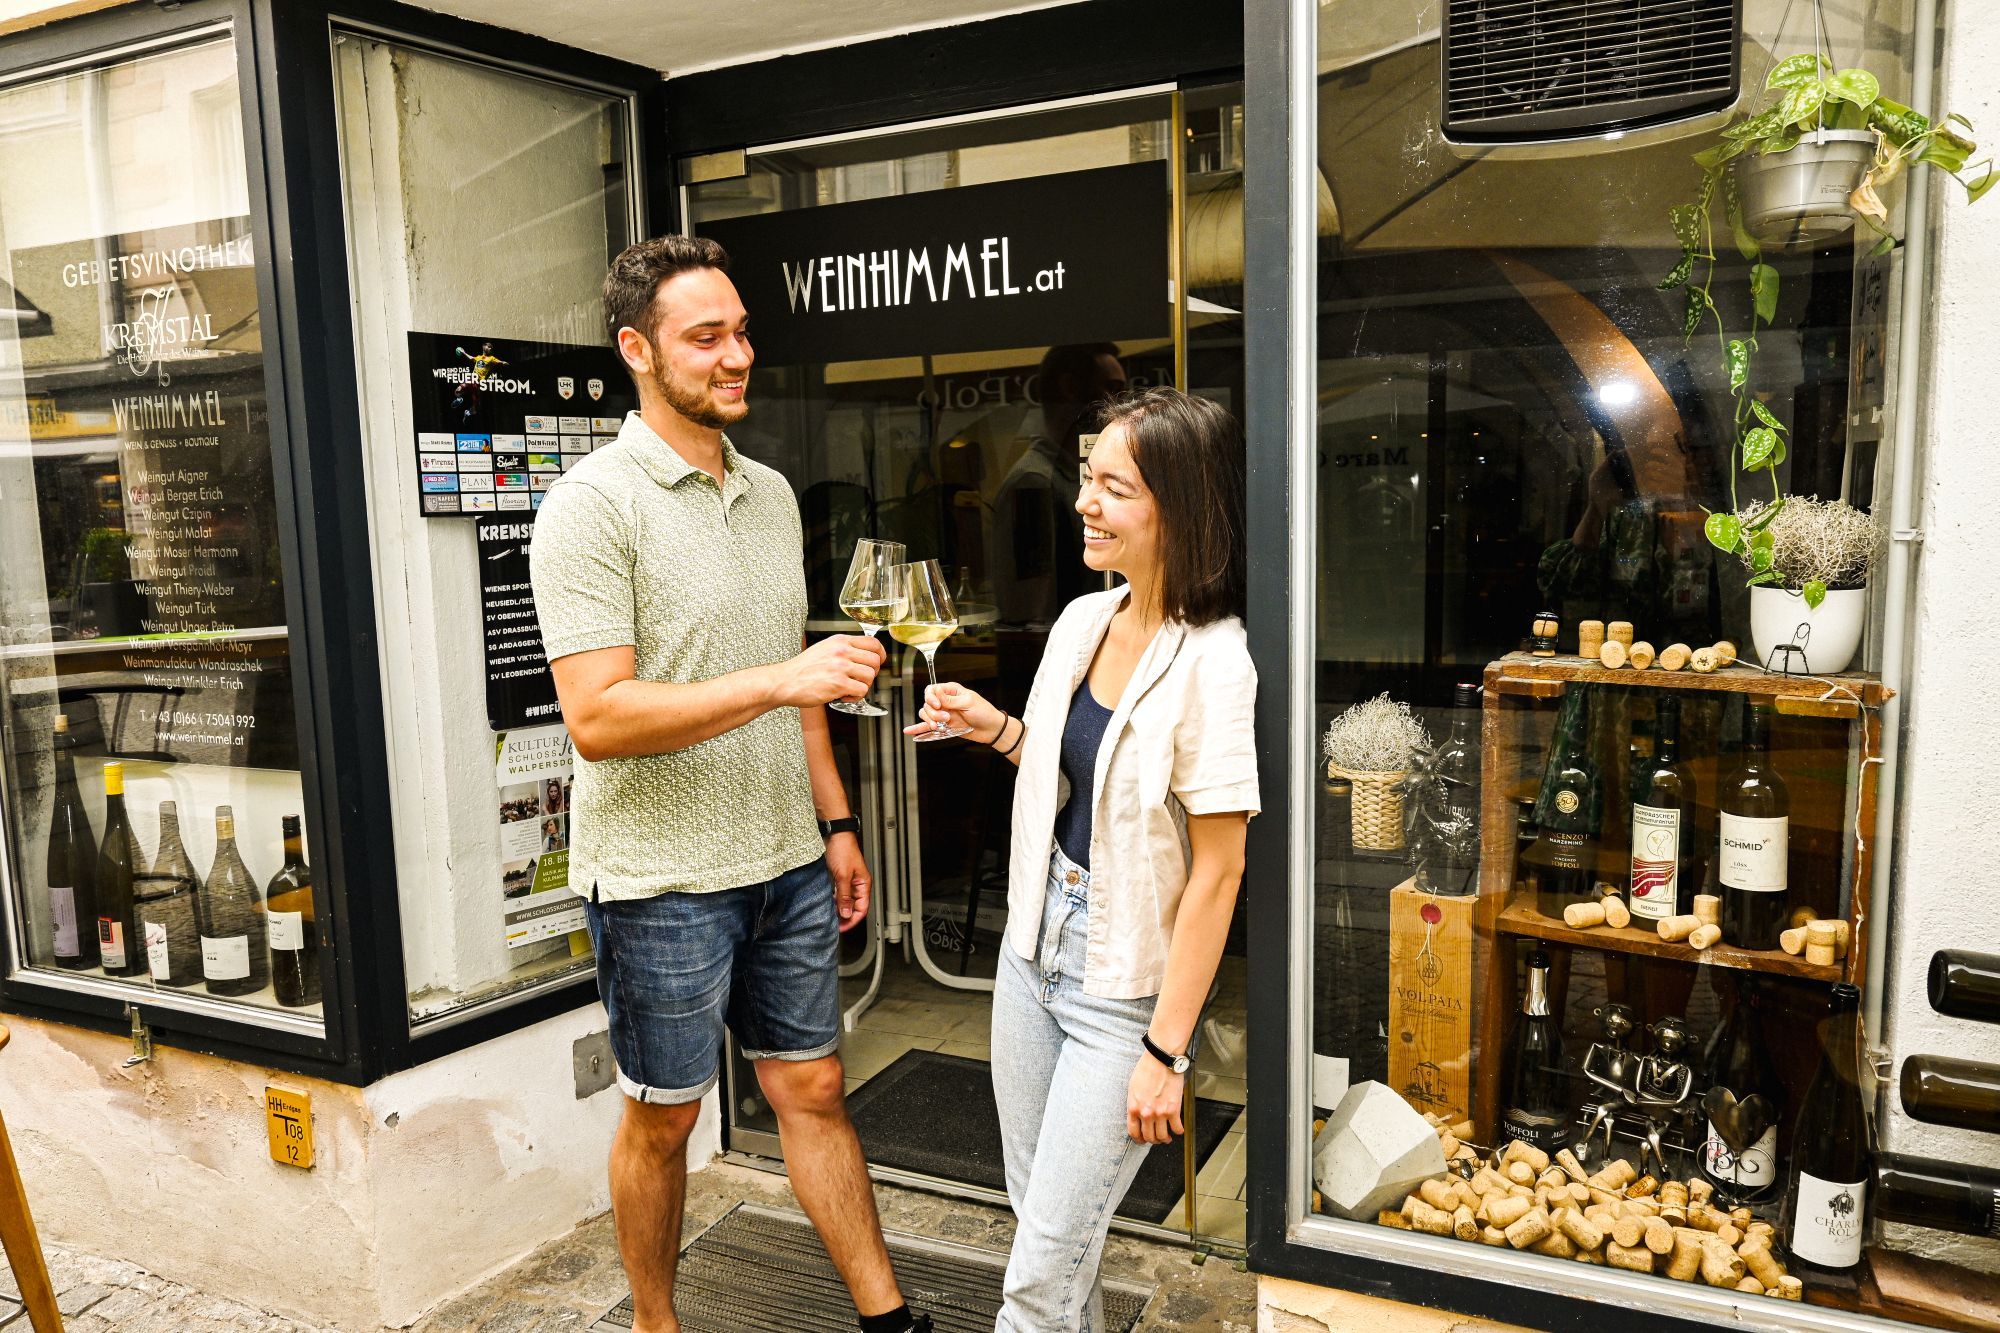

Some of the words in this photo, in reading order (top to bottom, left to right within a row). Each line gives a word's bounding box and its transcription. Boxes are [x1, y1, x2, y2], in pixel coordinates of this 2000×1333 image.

[62, 241, 251, 288] GEBIETSVINOTHEK
[782, 236, 1066, 315] WEINHIMMEL.at
[104, 313, 219, 350] KREMSTAL
[432, 368, 447, 379] WIR
[447, 372, 480, 384] FEUER
[480, 379, 536, 395] STROM.
[112, 390, 226, 431] WEINHIMMEL
[124, 440, 143, 451] WEIN
[150, 439, 176, 449] GENUSS
[184, 436, 219, 447] BOUTIQUE
[137, 470, 176, 486] Weingut
[177, 469, 208, 485] Aigner
[127, 489, 165, 505] Weingut
[199, 486, 223, 500] Erich
[142, 508, 179, 523] Weingut
[181, 507, 212, 523] Czipin
[145, 526, 183, 542] Weingut
[185, 526, 212, 539] Malat
[124, 546, 161, 561] Weingut
[163, 545, 191, 559] Moser
[193, 544, 239, 558] Hermann
[148, 564, 186, 579] Weingut
[188, 563, 216, 577] Proidl
[134, 582, 172, 598] Weingut
[173, 582, 235, 598] Thiery-Weber
[485, 585, 511, 593] WIENER
[155, 601, 193, 617] Weingut
[195, 601, 217, 614] Türk
[486, 614, 496, 622] SV
[497, 610, 536, 620] OBERWART
[141, 619, 178, 635] Weingut
[180, 620, 209, 636] Unger
[211, 621, 235, 633] Petra
[128, 637, 165, 653] Weingut
[123, 654, 197, 669] Weinmanufaktur
[198, 657, 263, 672] Wandraschek
[489, 656, 516, 666] WIENER
[501, 666, 546, 679] LEOBENDORF
[144, 673, 180, 690] Weingut
[182, 675, 218, 689] Winkler
[220, 676, 244, 690] Erich
[205, 713, 255, 728] 75041992
[508, 736, 560, 753] KULTUR
[508, 750, 557, 764] SCHLOSS
[1724, 838, 1763, 851] SCHMID
[543, 857, 555, 867] 18.
[1397, 986, 1463, 1010] VOLPAIA
[282, 1103, 301, 1113] Erdgas
[1503, 1120, 1539, 1138] TOFFOLI
[286, 1144, 299, 1161] 12
